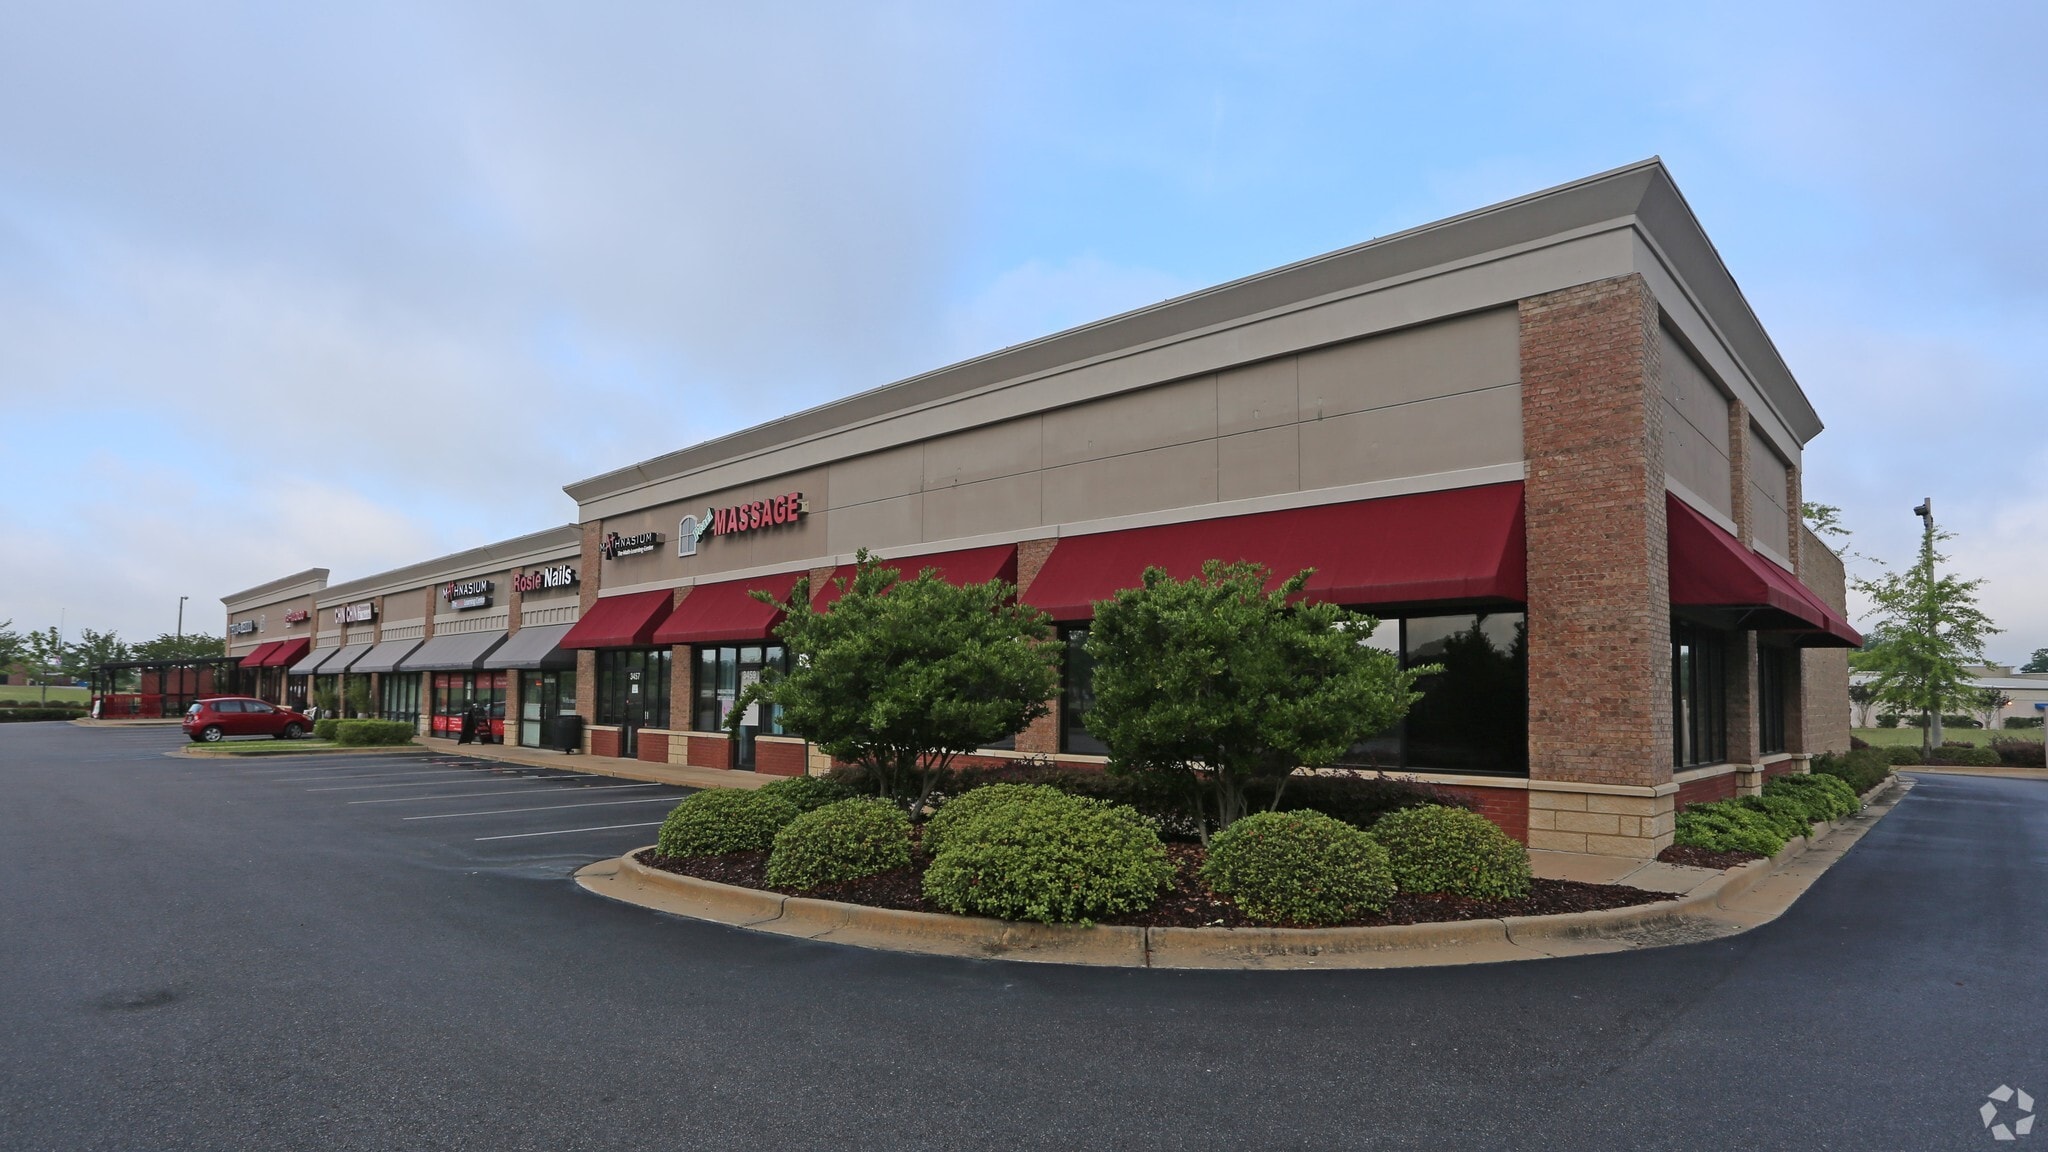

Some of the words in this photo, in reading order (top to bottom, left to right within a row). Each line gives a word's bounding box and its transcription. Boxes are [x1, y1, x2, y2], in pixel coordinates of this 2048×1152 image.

[714, 492, 798, 536] MASSAGE
[600, 533, 652, 556] MATHNASIUM
[443, 580, 487, 600] MATHNASIUM
[514, 573, 541, 592] Rosie
[544, 565, 571, 588] Nails
